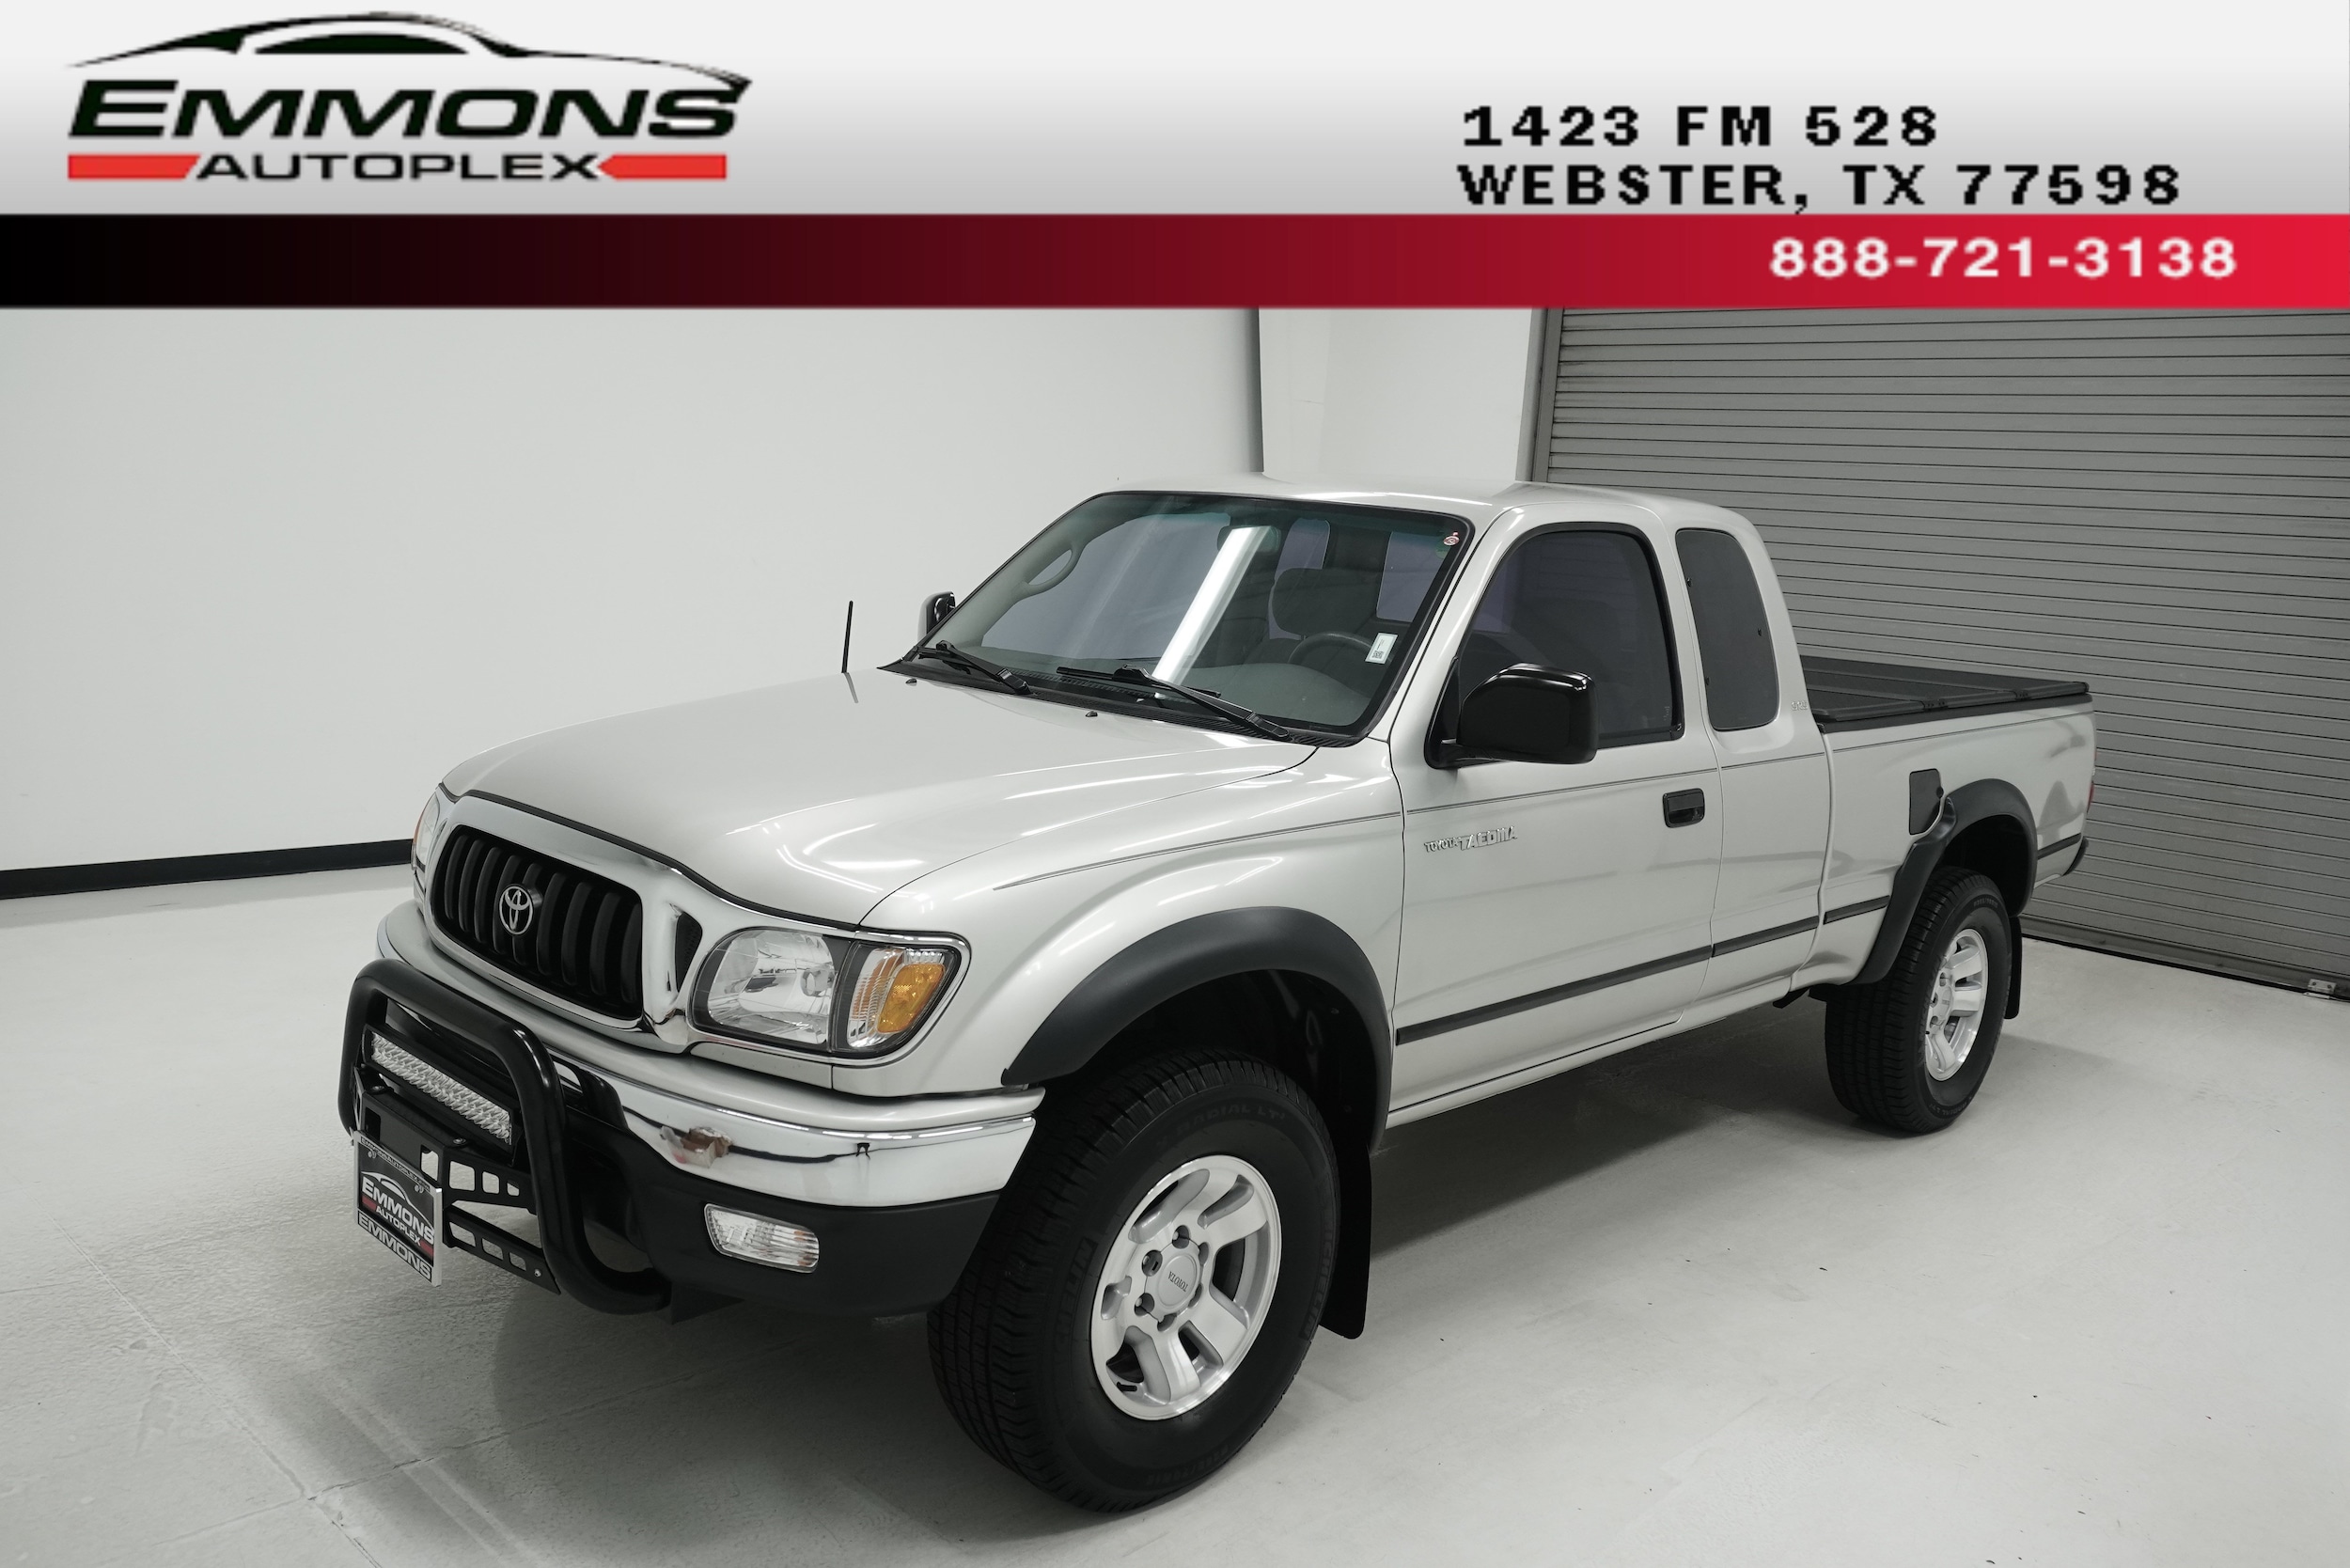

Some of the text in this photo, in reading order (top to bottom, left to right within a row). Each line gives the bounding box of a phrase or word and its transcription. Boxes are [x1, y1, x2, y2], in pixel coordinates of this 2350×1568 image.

[1424, 838, 1461, 853] TOYOTA
[361, 1176, 435, 1246] EMMONS
[376, 1205, 421, 1246] AUTOPLEX
[359, 1215, 431, 1280] EMMONS
[1167, 1270, 1189, 1293] TOYOTA
